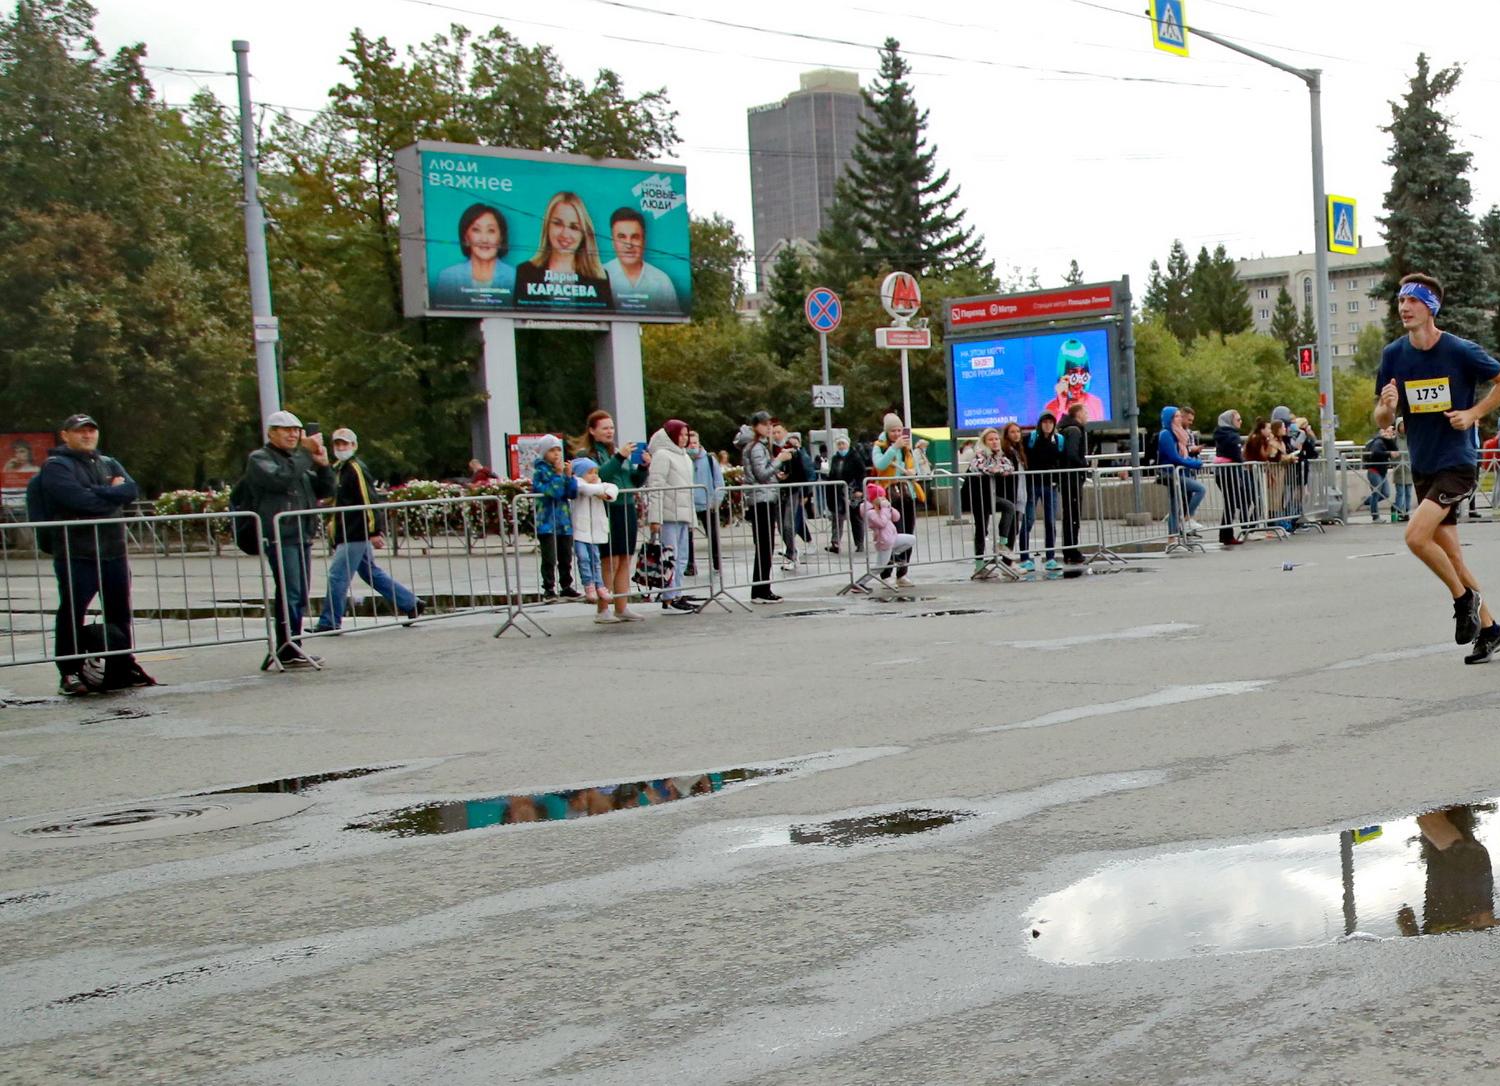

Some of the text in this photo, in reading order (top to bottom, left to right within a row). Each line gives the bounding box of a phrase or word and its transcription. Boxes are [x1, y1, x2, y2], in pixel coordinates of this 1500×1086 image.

[428, 172, 513, 192] важнее
[641, 188, 677, 200] НОВЫЕ
[641, 199, 672, 210] ЛЮДИ
[544, 269, 578, 284] Дарья
[526, 283, 597, 297] КАРАСЕВА
[998, 305, 1018, 314] Метро
[1415, 387, 1438, 400] 173
